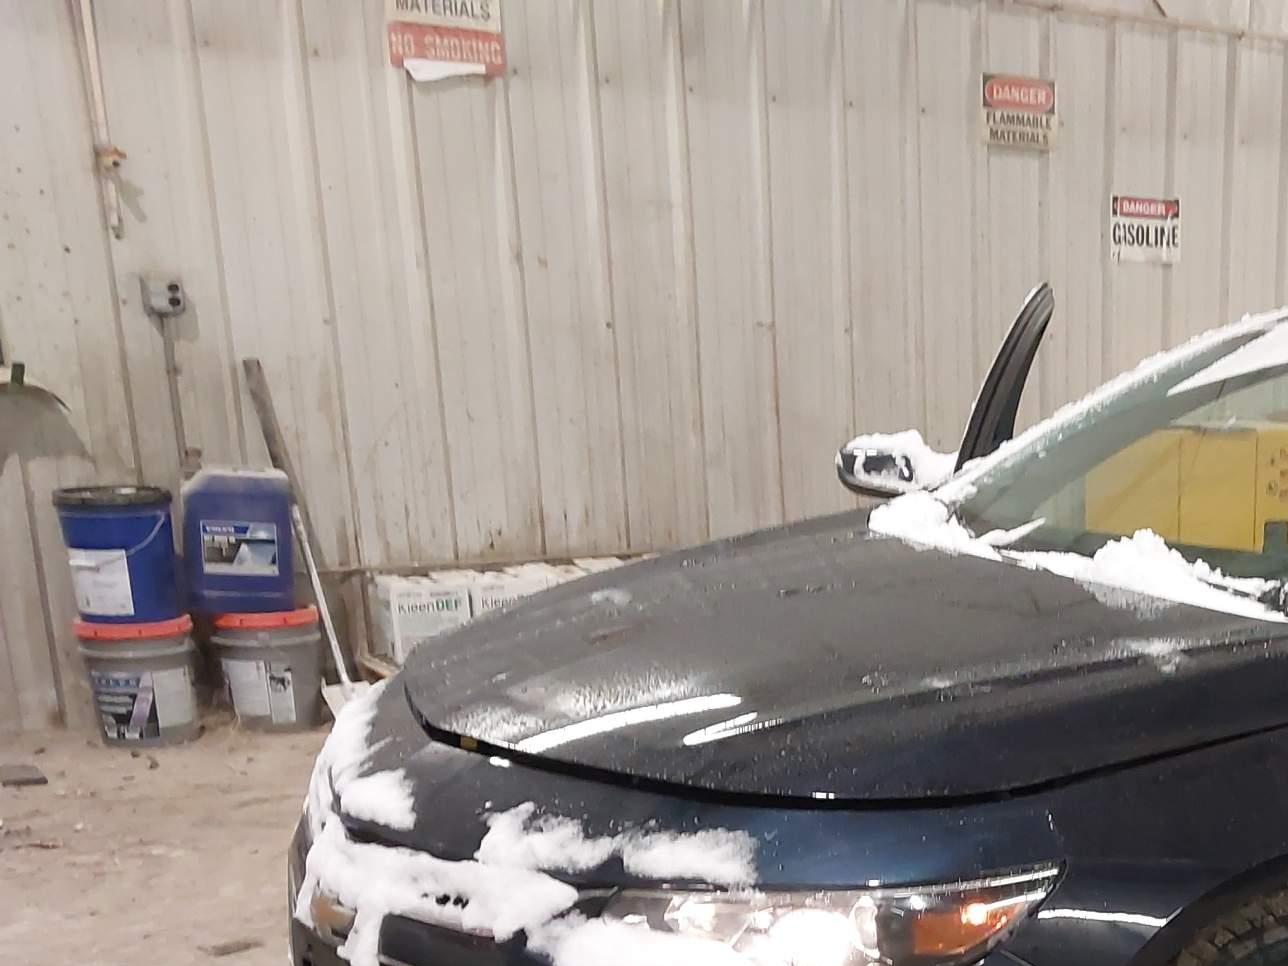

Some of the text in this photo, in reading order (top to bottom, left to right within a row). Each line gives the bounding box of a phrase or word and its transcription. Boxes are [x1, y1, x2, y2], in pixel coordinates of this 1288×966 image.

[391, 32, 502, 64] NO SMOKING
[992, 84, 1046, 105] DANGER
[986, 110, 1051, 130] FLAMMABLE
[989, 127, 1049, 145] MATERIALS
[1122, 199, 1166, 216] DANGER
[397, 597, 463, 616] KleenDEF
